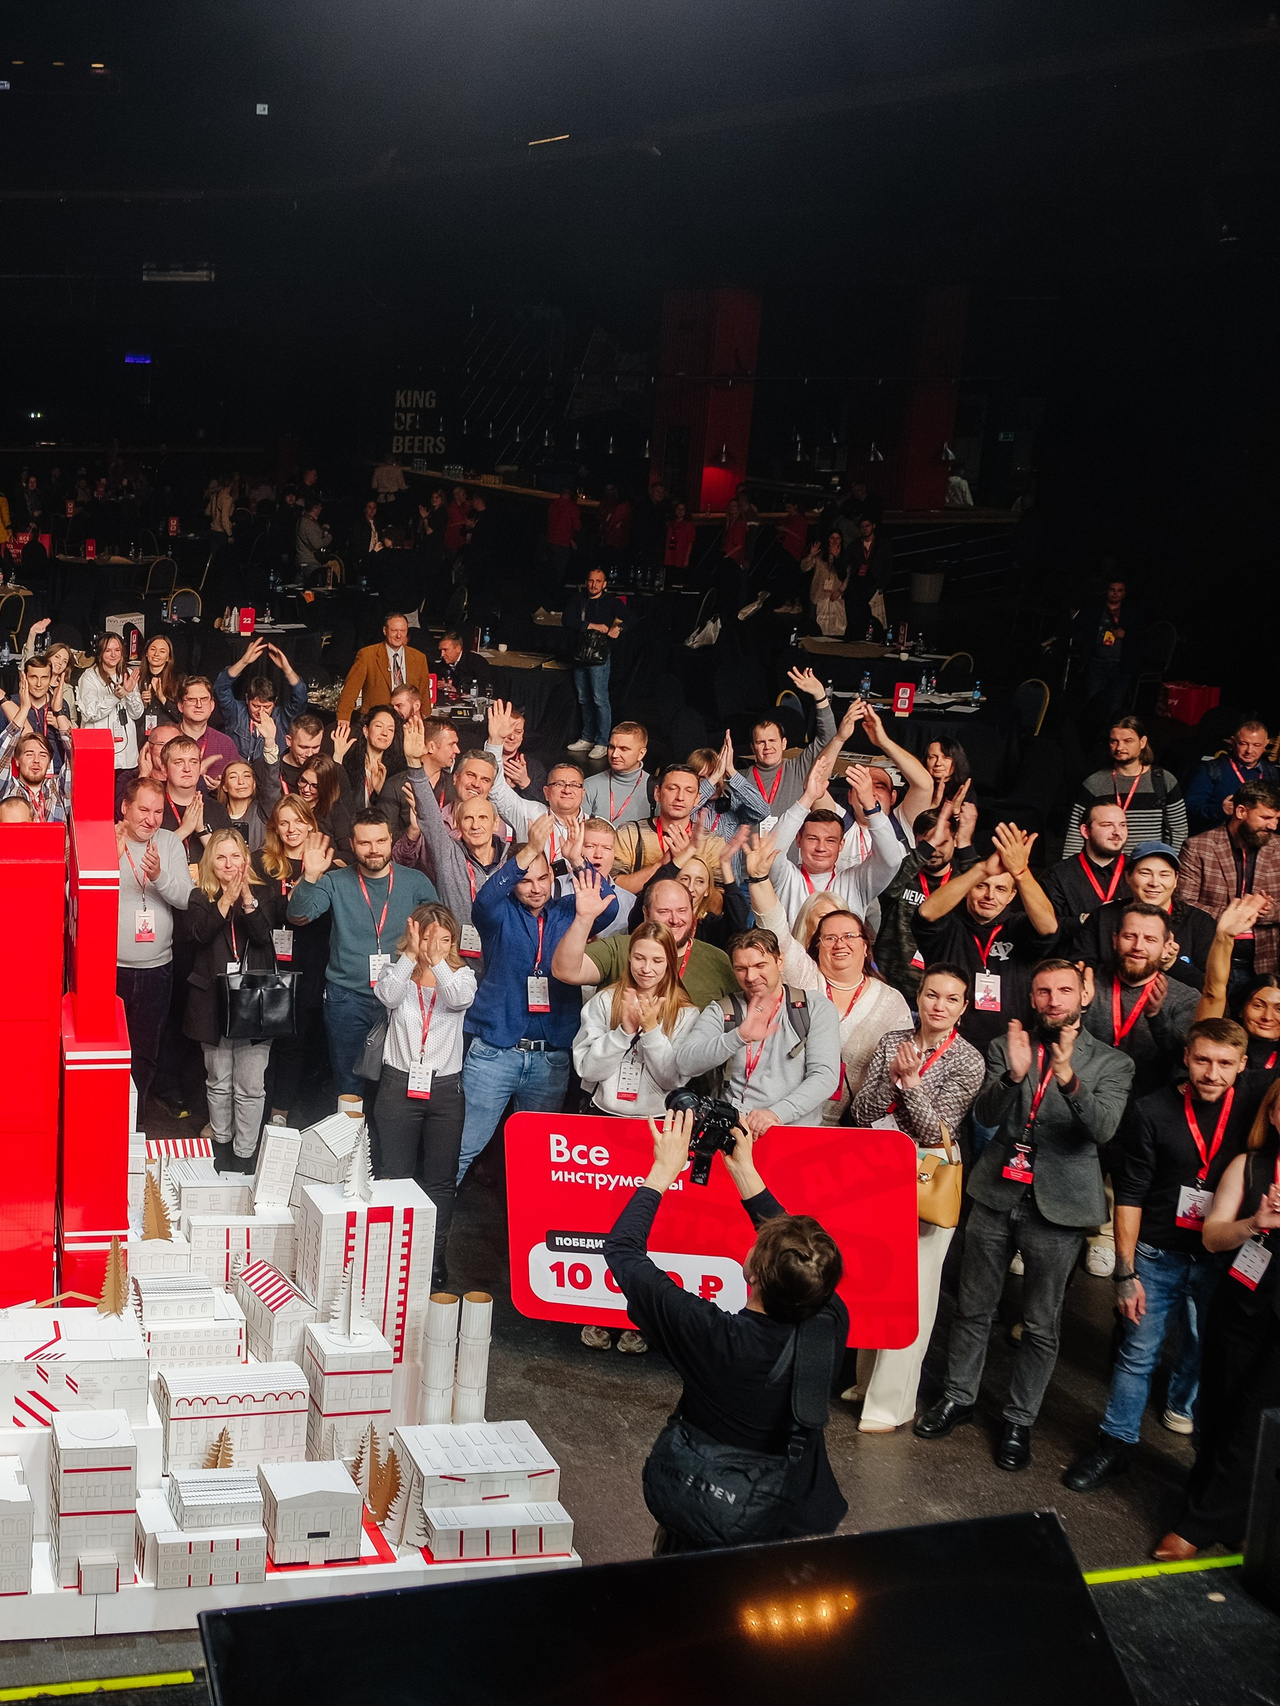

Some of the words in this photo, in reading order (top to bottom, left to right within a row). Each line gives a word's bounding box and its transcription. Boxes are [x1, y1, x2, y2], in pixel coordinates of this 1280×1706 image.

[395, 390, 437, 408] KING
[392, 435, 446, 454] BEERS
[549, 1133, 610, 1166] Все
[551, 1169, 683, 1191] инструмеы
[555, 1236, 605, 1249] ПОБЕДИ
[549, 1260, 592, 1290] 10
